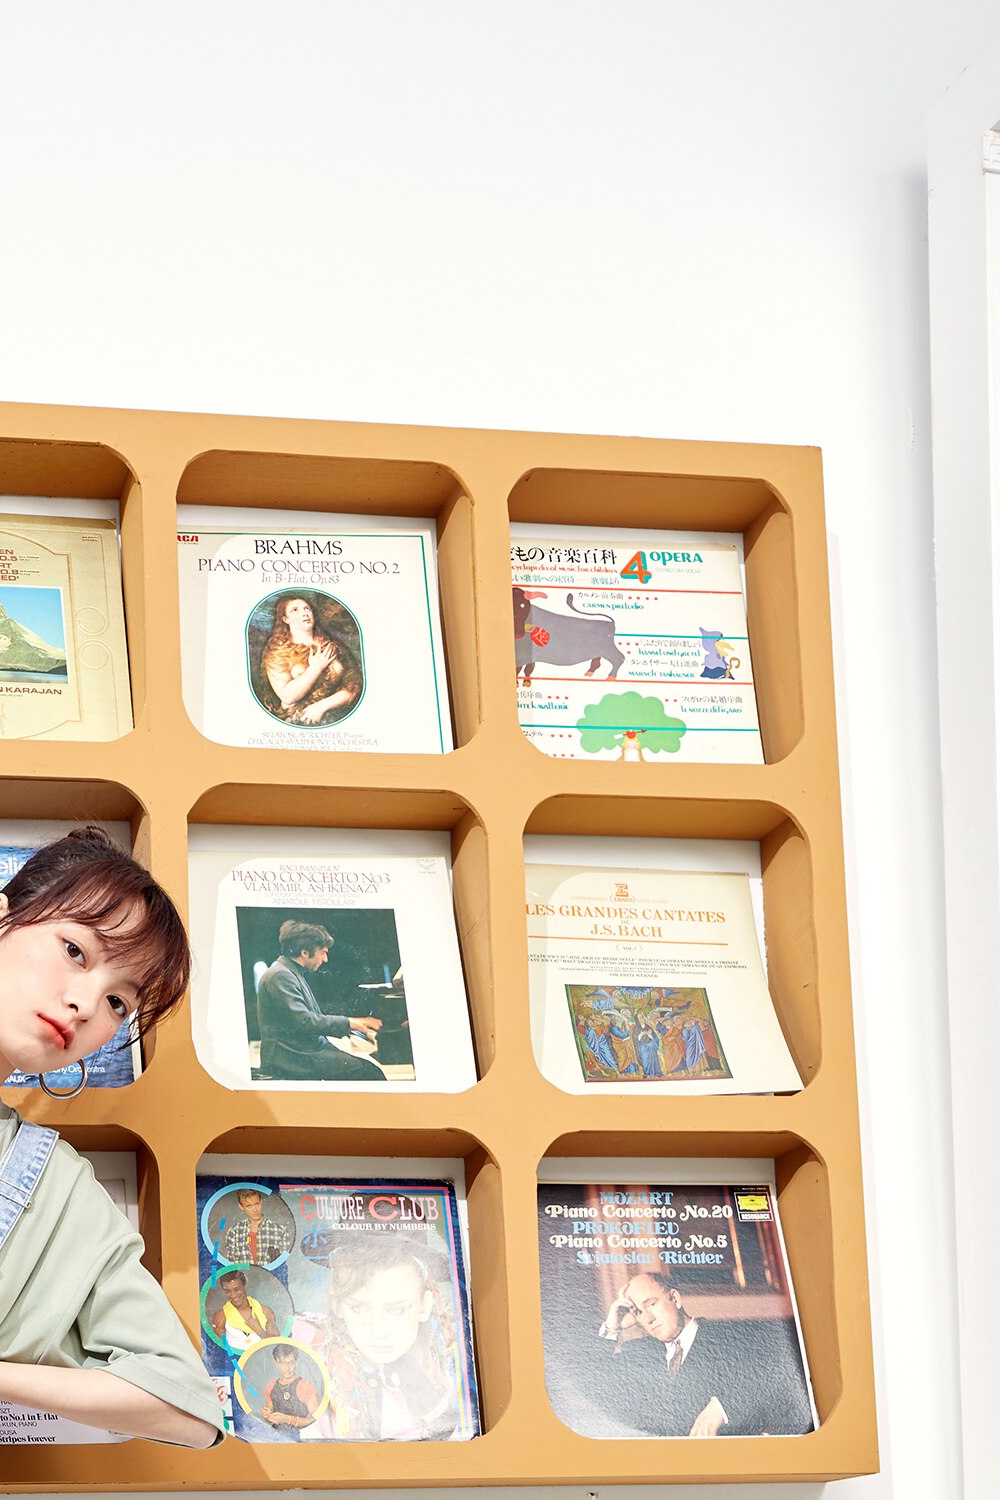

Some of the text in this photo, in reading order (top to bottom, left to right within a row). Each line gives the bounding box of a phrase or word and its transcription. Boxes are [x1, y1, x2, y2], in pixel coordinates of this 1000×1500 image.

[254, 540, 343, 555] BRAHMS
[650, 551, 704, 566] OPERA
[199, 558, 255, 572] PIANO
[261, 560, 355, 574] CONCERTO
[620, 551, 653, 584] 4
[5, 687, 63, 695] KARAJAN
[232, 870, 277, 881] PIANO
[280, 872, 359, 883] CONCERTO
[243, 882, 380, 893] VLADIMIR ASHKENAZY
[526, 904, 726, 924] LES GRANDES CANTATES
[619, 926, 663, 938] BACH
[600, 1191, 673, 1205] MOZART
[300, 1196, 439, 1220] CULTURE CLUB
[545, 1205, 733, 1221] Piano Concerto No.20
[332, 1223, 373, 1231] COLOUR
[375, 1223, 388, 1231] BY
[572, 1221, 679, 1235] PROKOFIEV
[549, 1235, 728, 1251] Piano Concerto No.5
[659, 1251, 724, 1264] Richter
